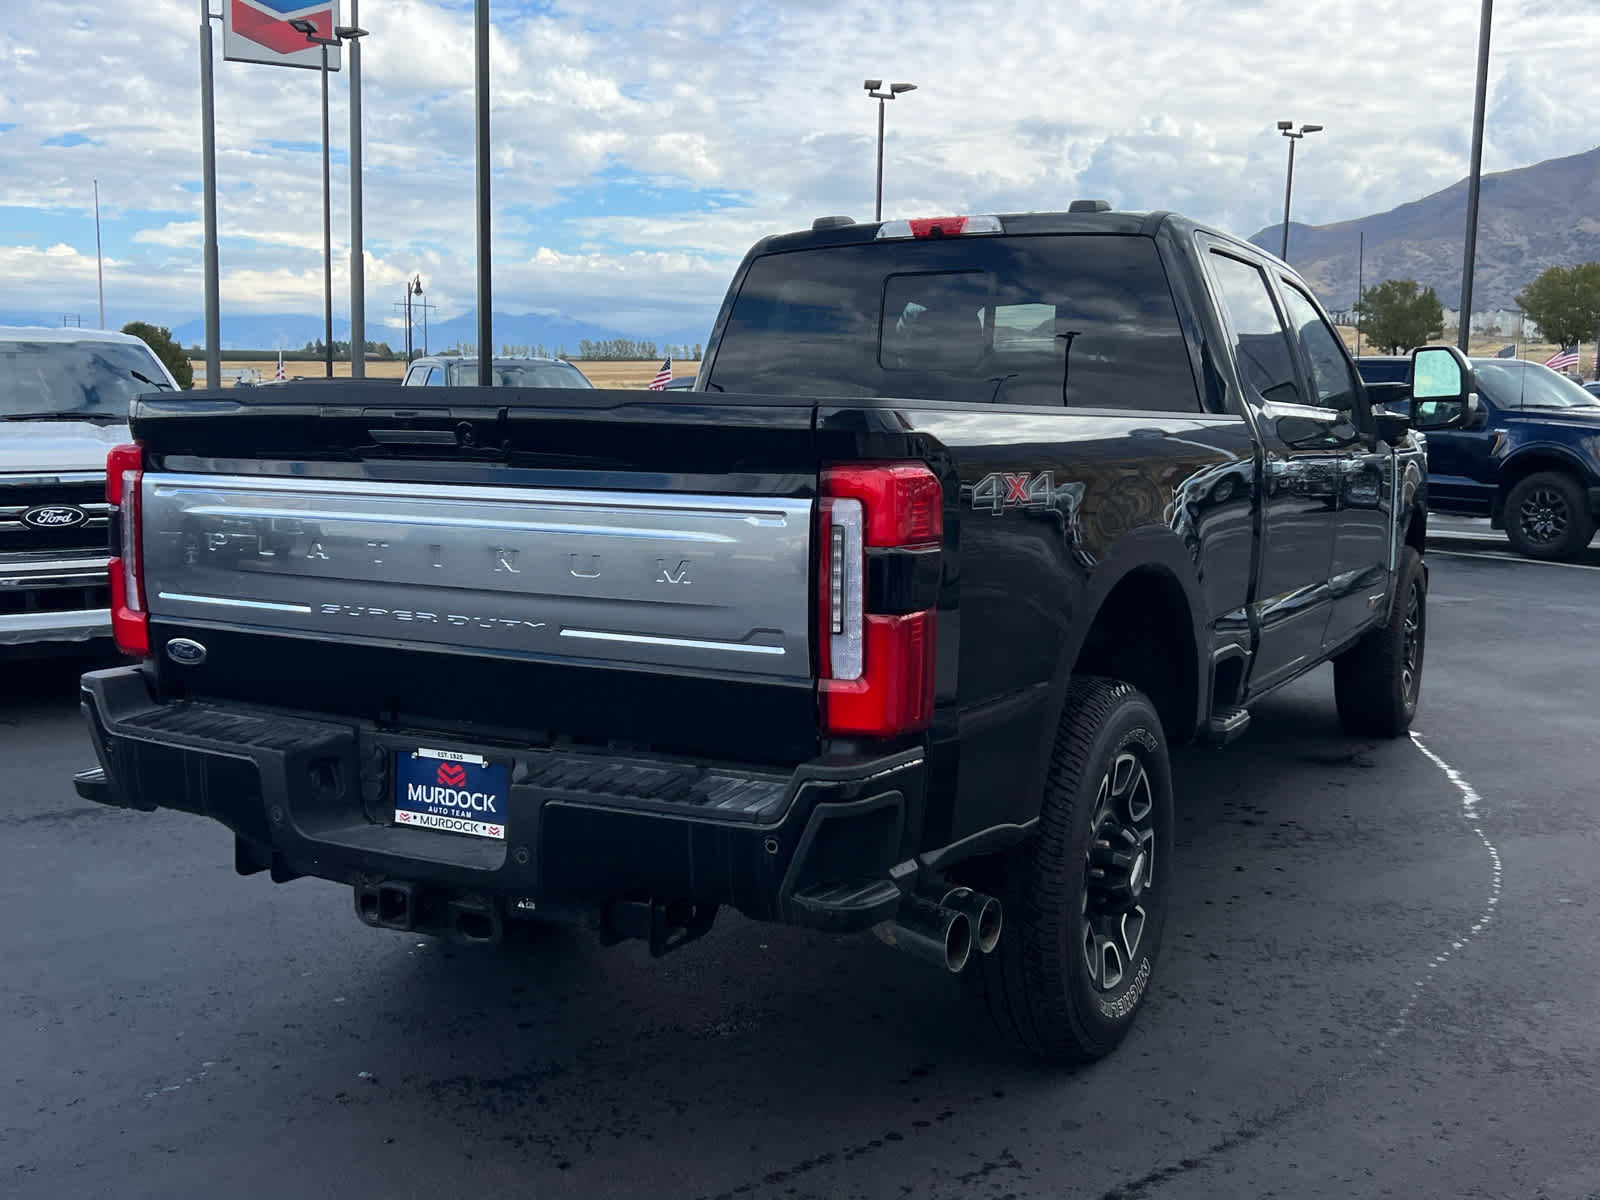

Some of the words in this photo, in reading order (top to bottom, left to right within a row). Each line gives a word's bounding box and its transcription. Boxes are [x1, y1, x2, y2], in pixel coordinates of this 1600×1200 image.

[36, 509, 73, 524] Ford
[205, 532, 692, 585] PLATINUM
[320, 603, 439, 624] SUPER
[447, 613, 546, 630] DUTY
[408, 783, 496, 813] MURDOCK
[428, 805, 449, 815] AUTO
[451, 808, 472, 818] TEAM
[420, 815, 479, 833] MURDOCK
